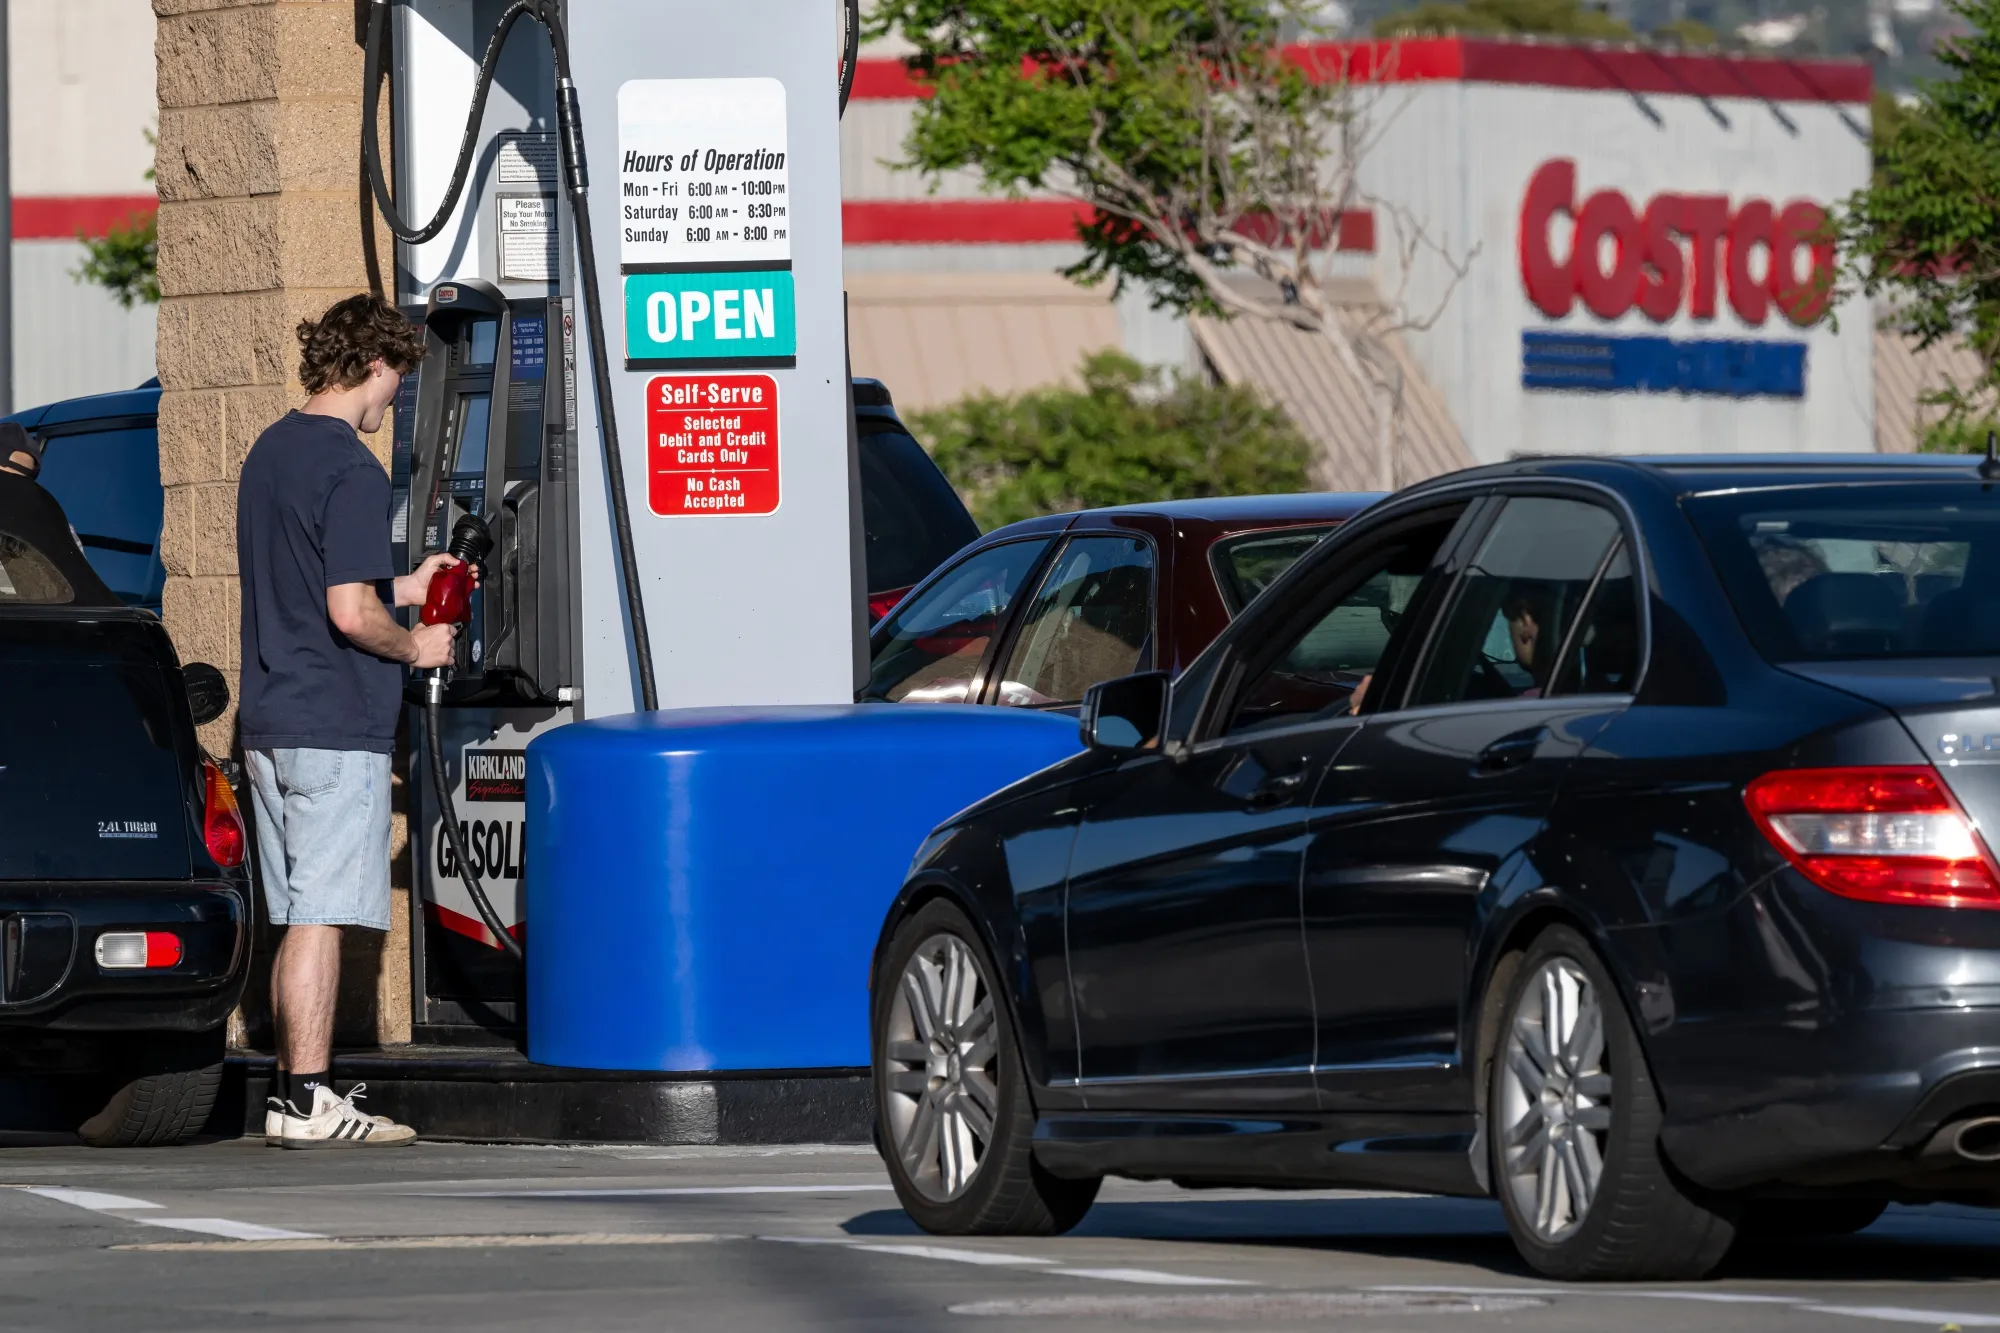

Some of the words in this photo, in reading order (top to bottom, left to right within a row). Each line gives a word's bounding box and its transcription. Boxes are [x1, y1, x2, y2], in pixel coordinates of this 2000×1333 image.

[623, 150, 674, 173] Hours
[680, 149, 699, 171] of
[704, 148, 785, 174] Operation
[623, 182, 649, 197] Mon
[662, 181, 678, 196] Fri
[688, 182, 712, 196] 6:00
[714, 185, 728, 195] AM
[741, 180, 772, 195] 10:00
[772, 184, 785, 194] PM
[515, 200, 541, 209] Please
[624, 204, 678, 221] Saturday
[688, 205, 713, 219] 6:00
[715, 208, 729, 218] AM
[747, 203, 772, 218] 8:30
[773, 207, 786, 217] PM
[503, 210, 517, 219] Stop
[518, 210, 533, 218] Your
[534, 210, 554, 218] Motor
[519, 219, 547, 228] Smoking
[625, 227, 669, 243] Sunday
[686, 227, 710, 242] 6:00
[716, 230, 729, 240] AM
[744, 226, 768, 241] 8:00
[774, 229, 786, 239] PM
[1518, 157, 1836, 326] COSTCO
[646, 288, 775, 344] OPEN
[661, 383, 763, 405] Self-Serve
[684, 415, 741, 431] Selected
[659, 432, 693, 447] Debit
[698, 432, 721, 447] and
[726, 431, 766, 446] Credit
[677, 449, 714, 464] Cards
[720, 448, 748, 465] Only
[687, 478, 703, 492] No
[709, 477, 740, 491] Cash
[684, 493, 745, 510] Accepted
[468, 755, 525, 779] KIRKLAND
[469, 780, 525, 800] Signature
[124, 821, 158, 833] TURBO
